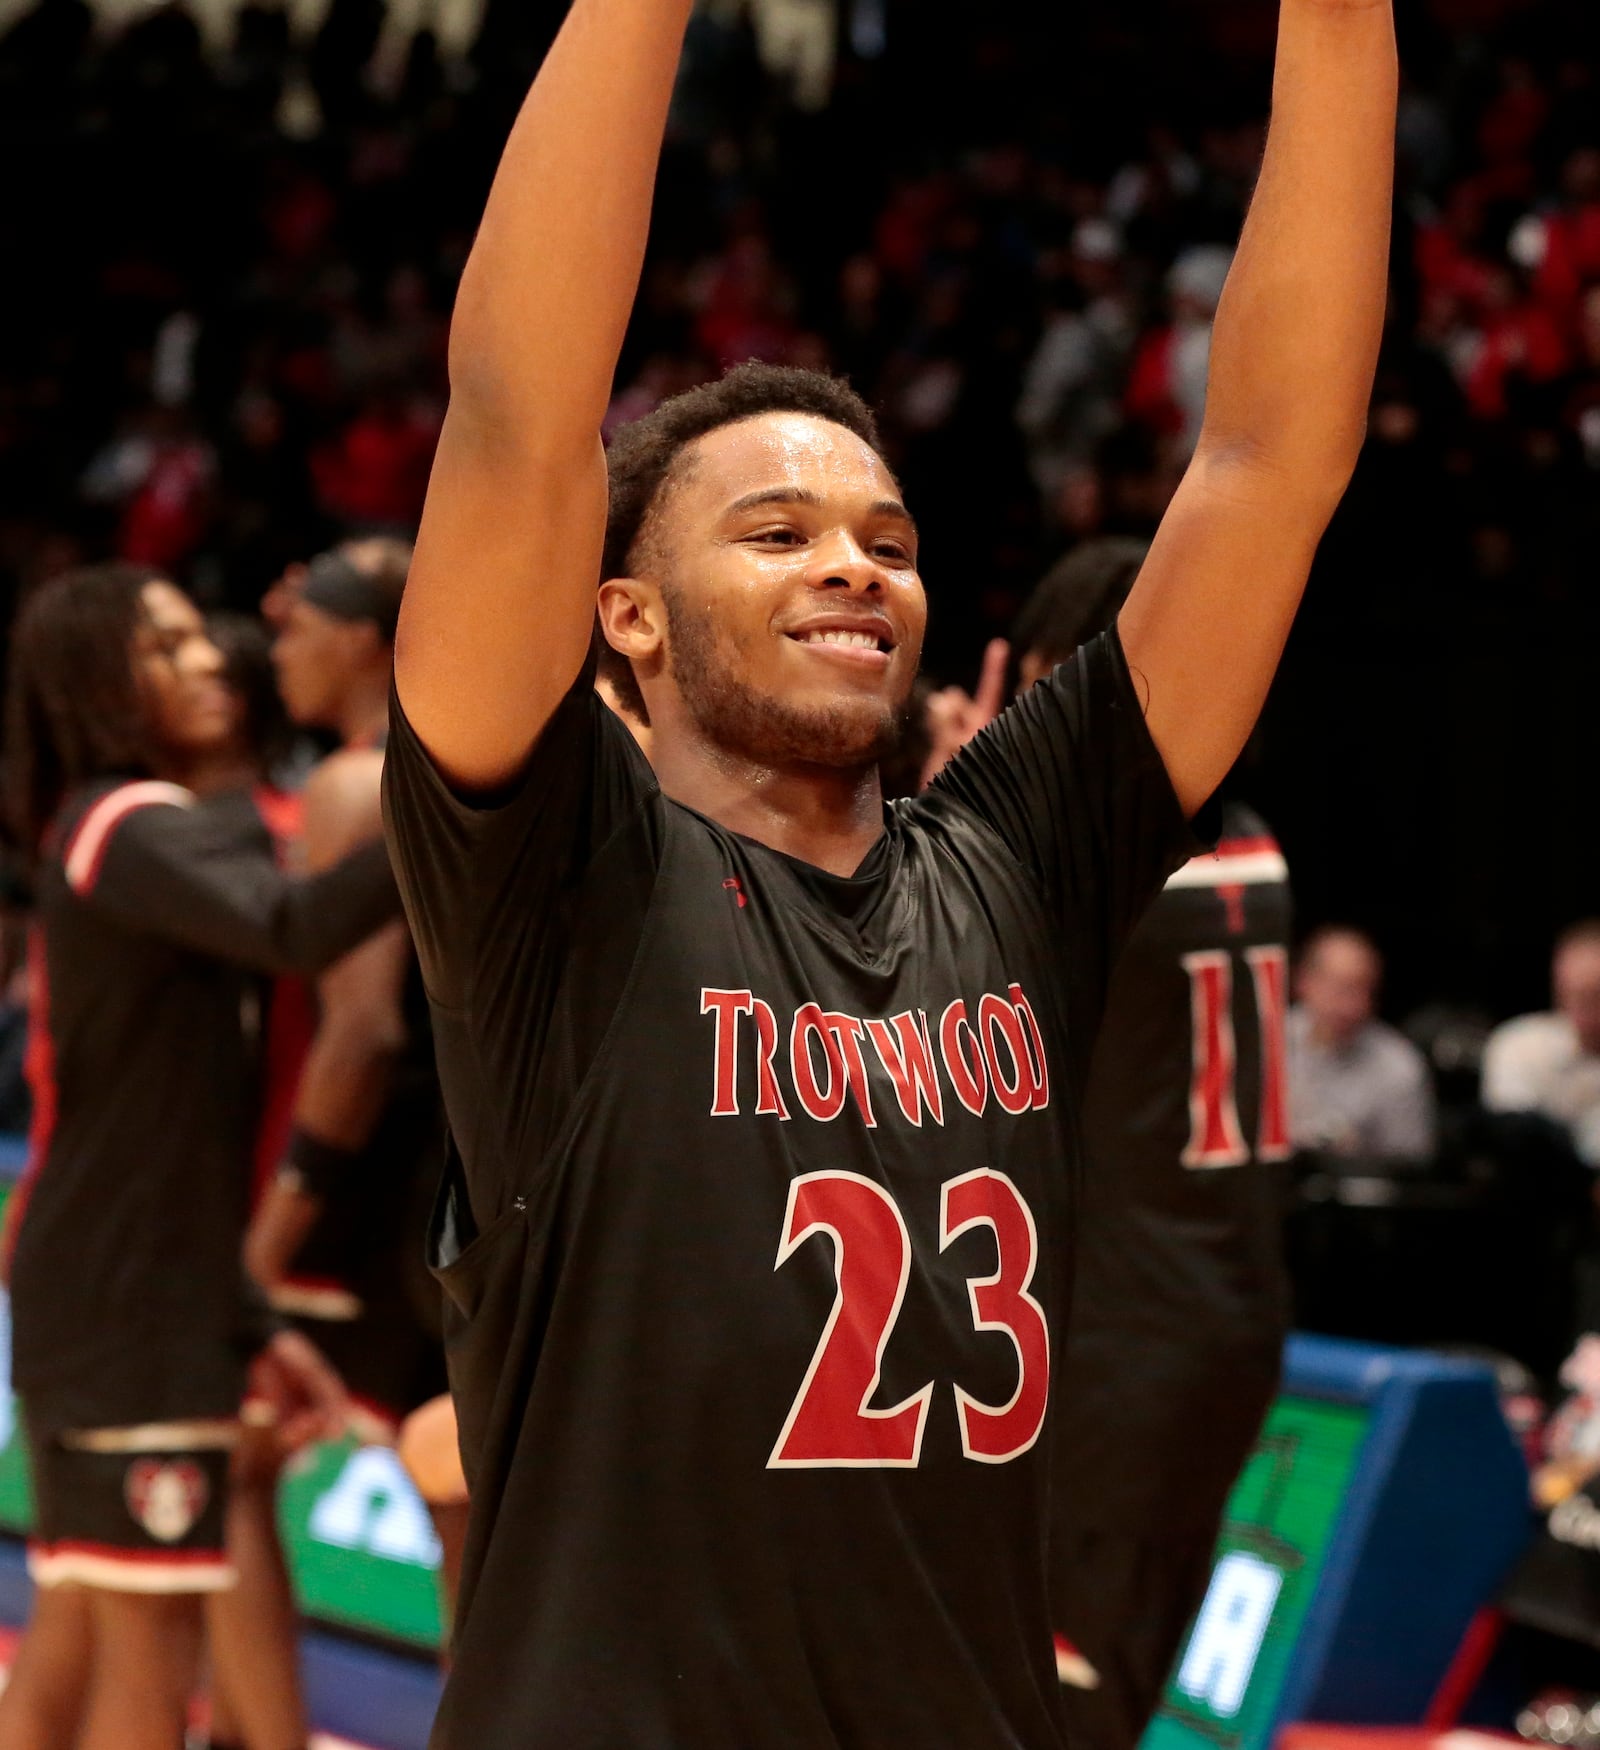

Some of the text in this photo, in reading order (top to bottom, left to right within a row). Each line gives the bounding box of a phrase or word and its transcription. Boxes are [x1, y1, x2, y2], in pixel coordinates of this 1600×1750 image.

[700, 983, 1050, 1129] TROTWOOD
[1180, 944, 1292, 1169] 11
[765, 1166, 1050, 1469] 23
